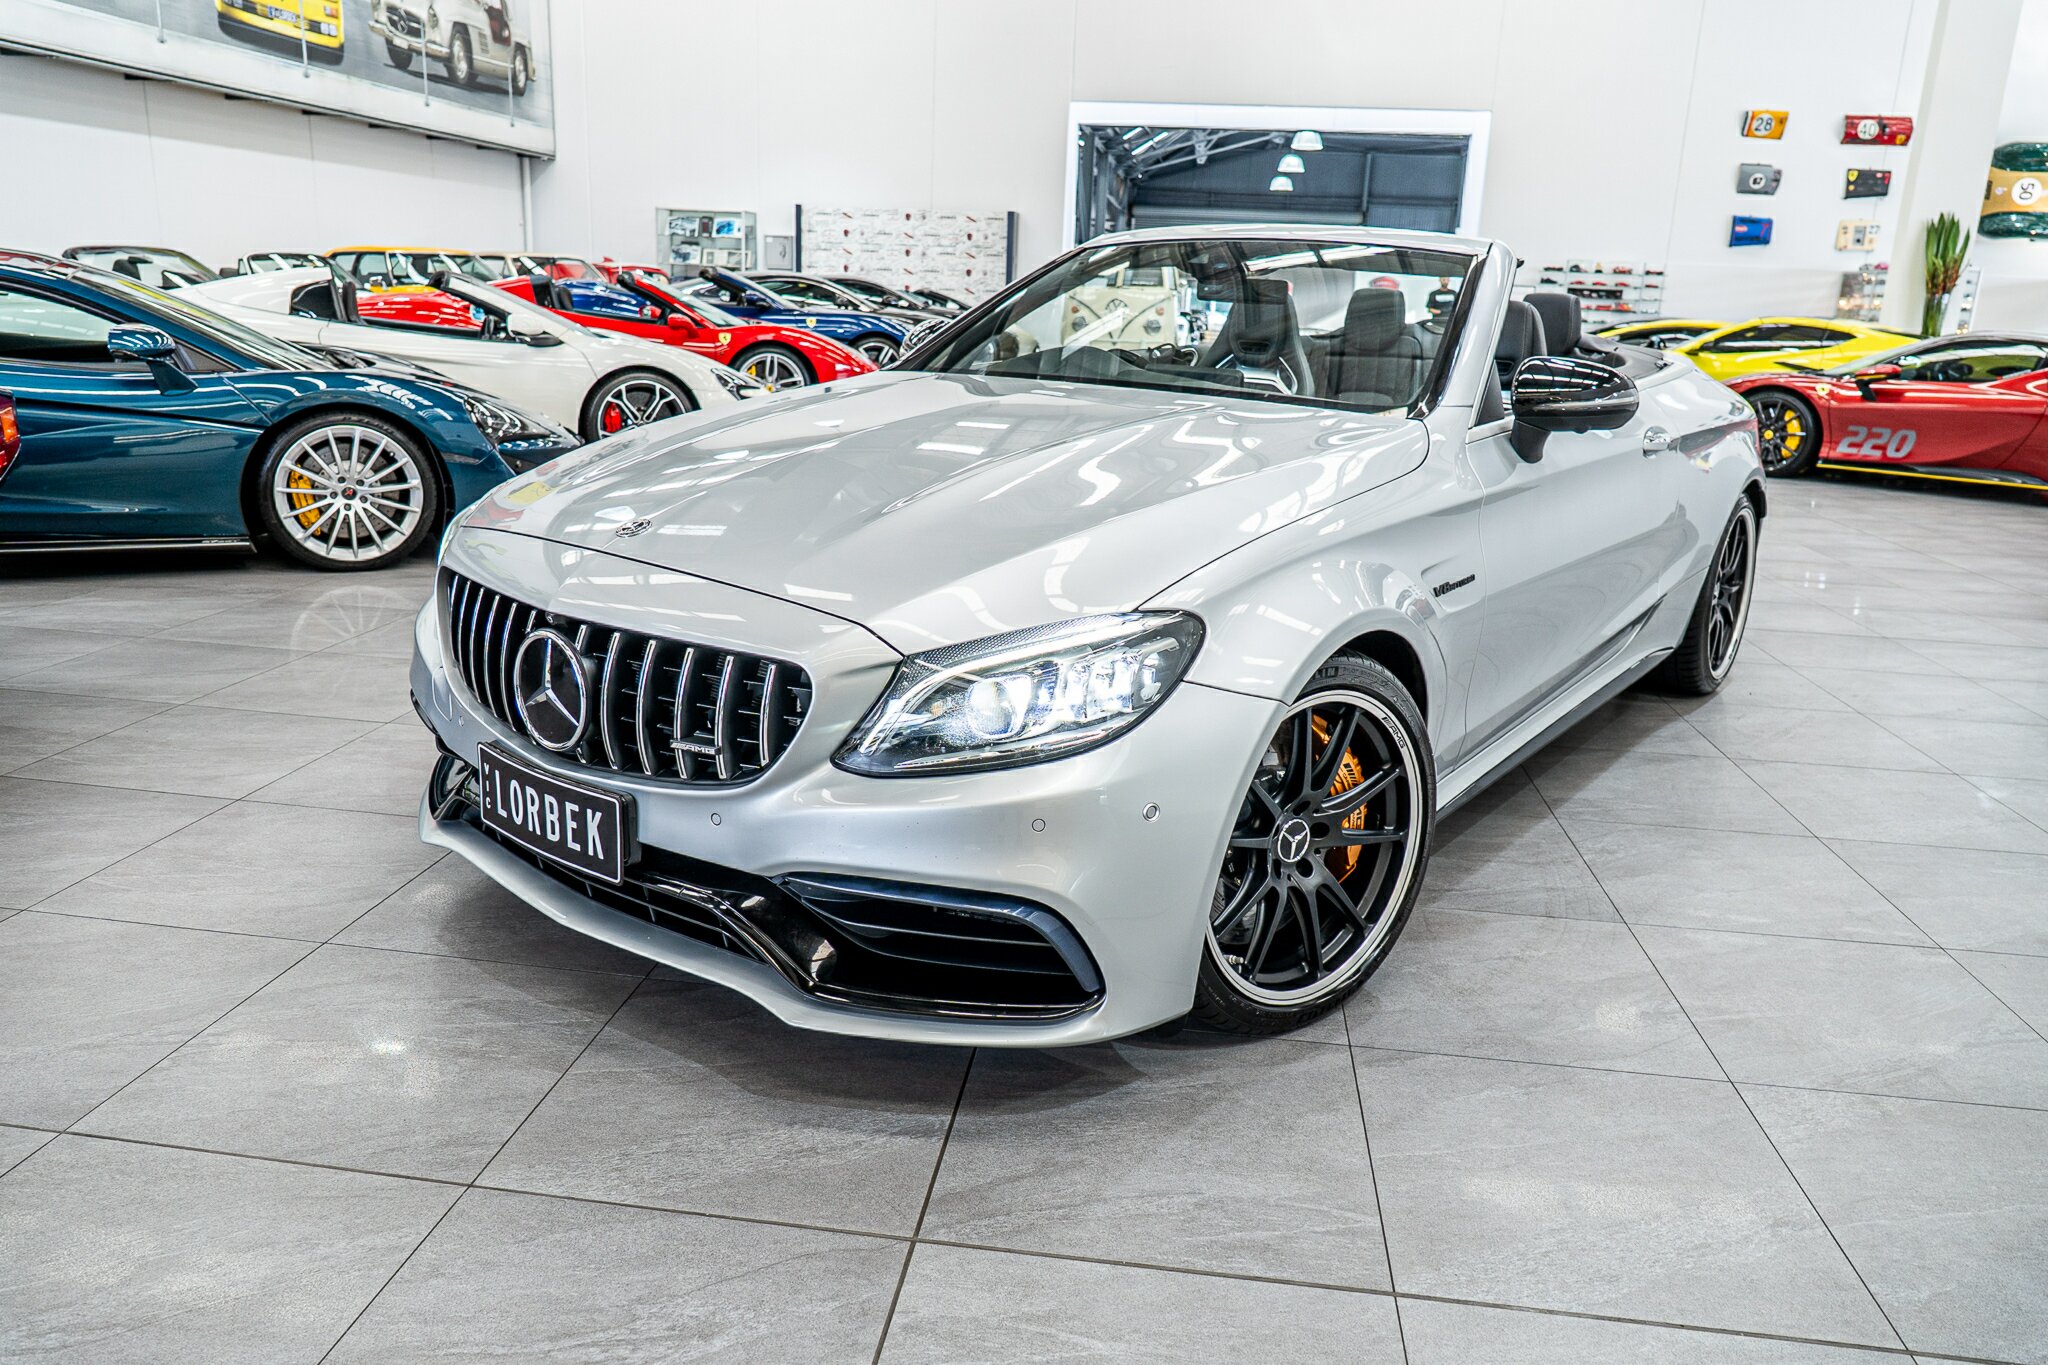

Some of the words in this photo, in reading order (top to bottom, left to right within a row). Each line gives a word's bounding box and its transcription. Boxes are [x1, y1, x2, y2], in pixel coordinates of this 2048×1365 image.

[1755, 117, 1773, 132] 28
[1860, 123, 1876, 137] 40
[2019, 183, 2035, 200] 50
[1836, 425, 1917, 458] 220
[683, 744, 716, 755] AMG
[483, 762, 492, 809] VIC
[494, 769, 605, 860] LORBEK
